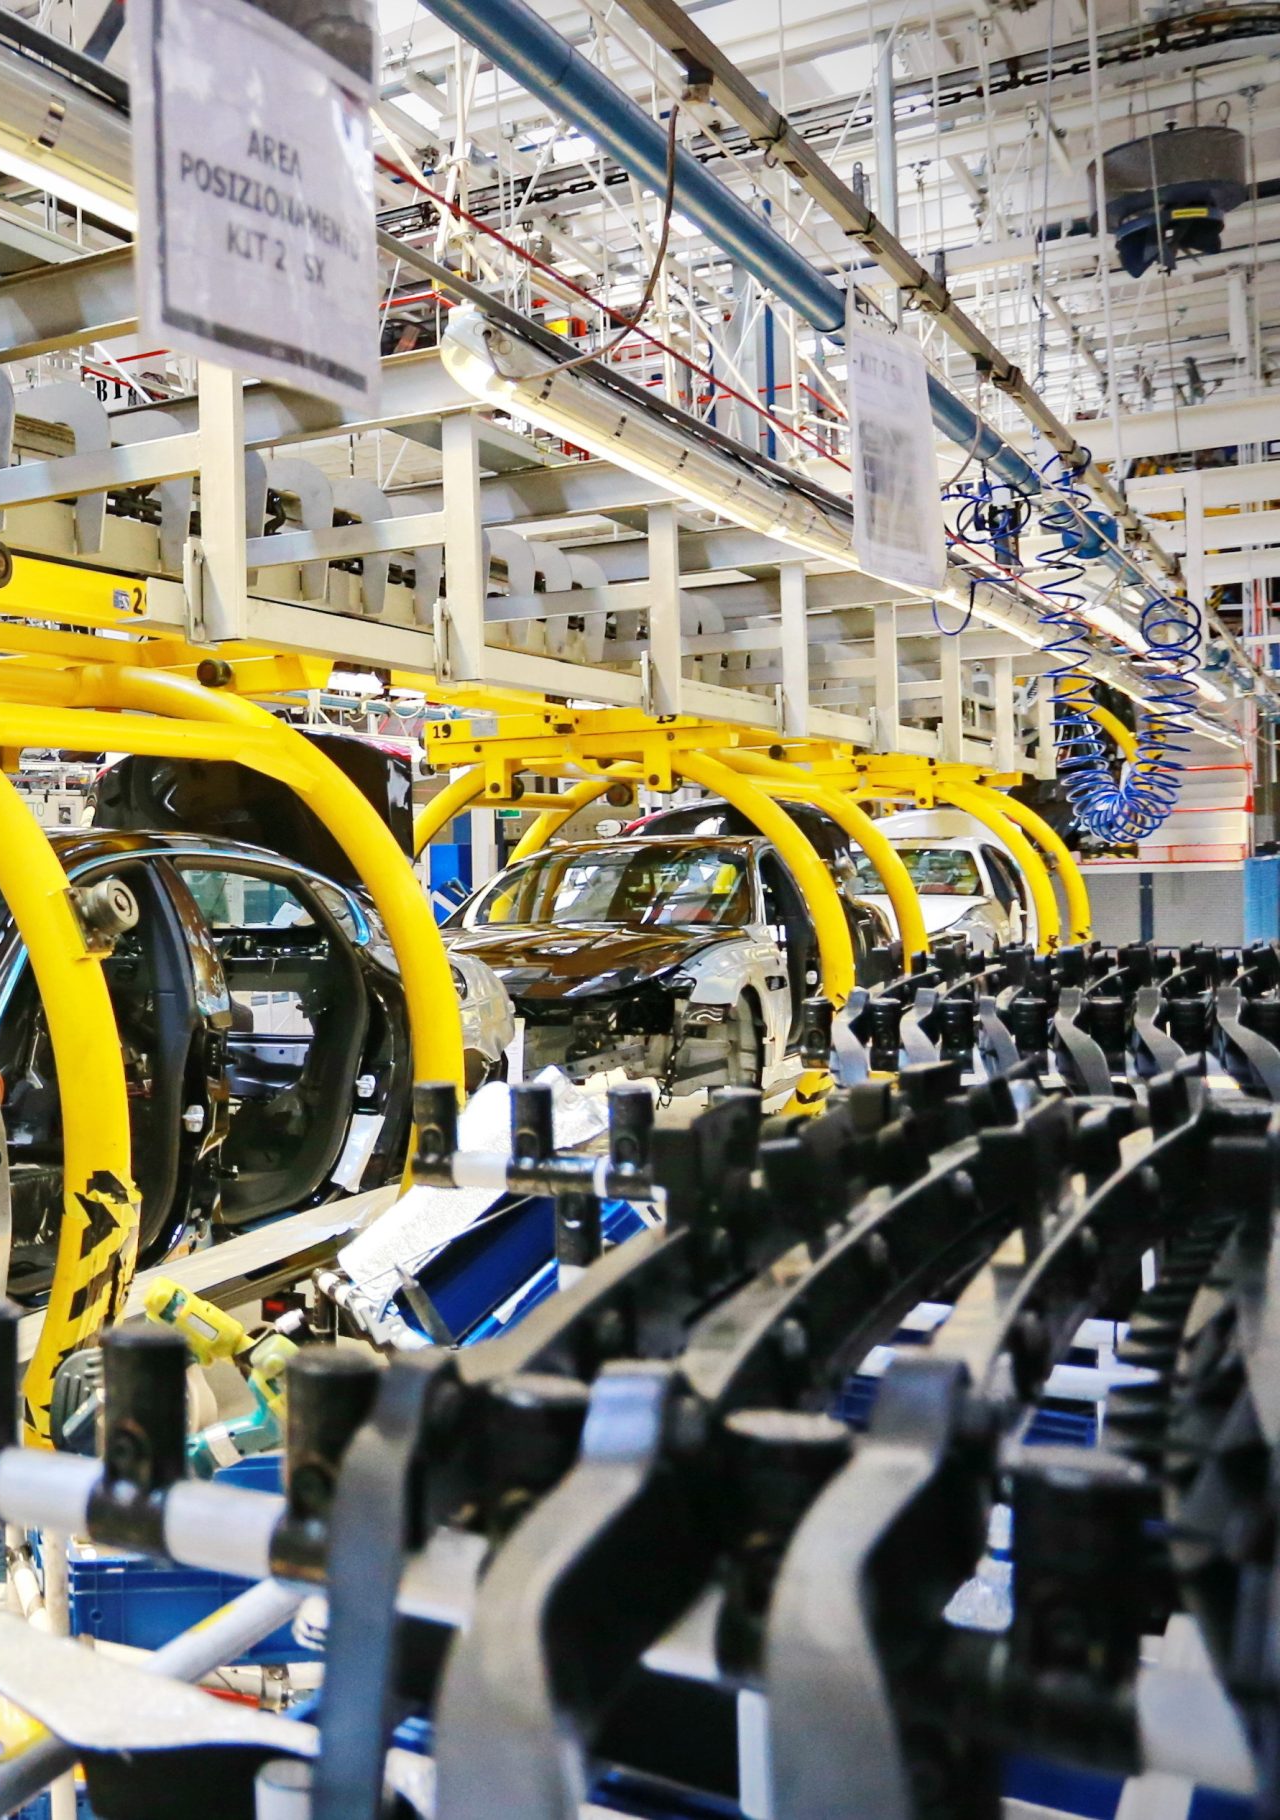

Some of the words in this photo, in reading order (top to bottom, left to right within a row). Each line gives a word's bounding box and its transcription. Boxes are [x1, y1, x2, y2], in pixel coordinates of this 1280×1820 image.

[247, 129, 302, 181] AREA
[227, 221, 268, 263] KIT
[274, 239, 288, 273] 2
[304, 253, 327, 290] SX
[132, 587, 147, 615] 2
[432, 723, 452, 739] 19
